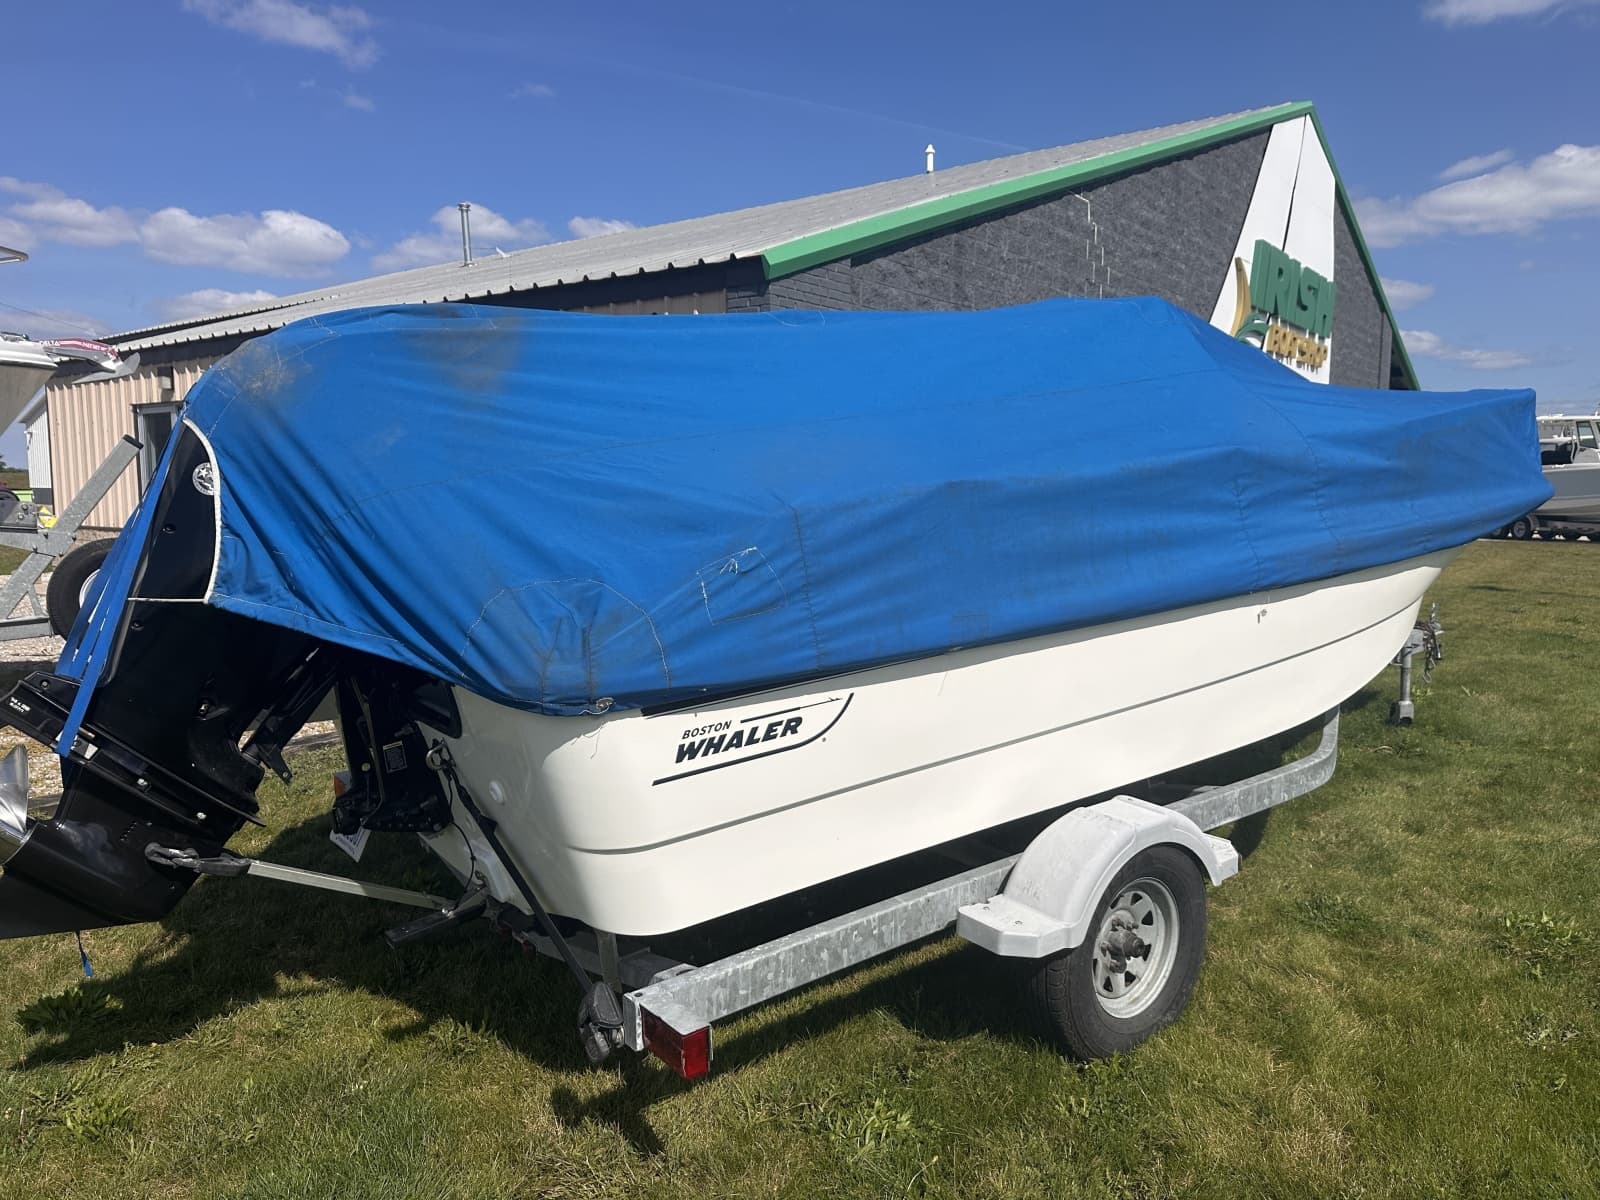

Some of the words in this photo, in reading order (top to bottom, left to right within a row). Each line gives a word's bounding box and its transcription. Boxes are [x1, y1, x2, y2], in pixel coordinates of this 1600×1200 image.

[1249, 239, 1335, 338] IRISH
[675, 716, 803, 764] WHALER
[681, 720, 732, 739] BOSTON
